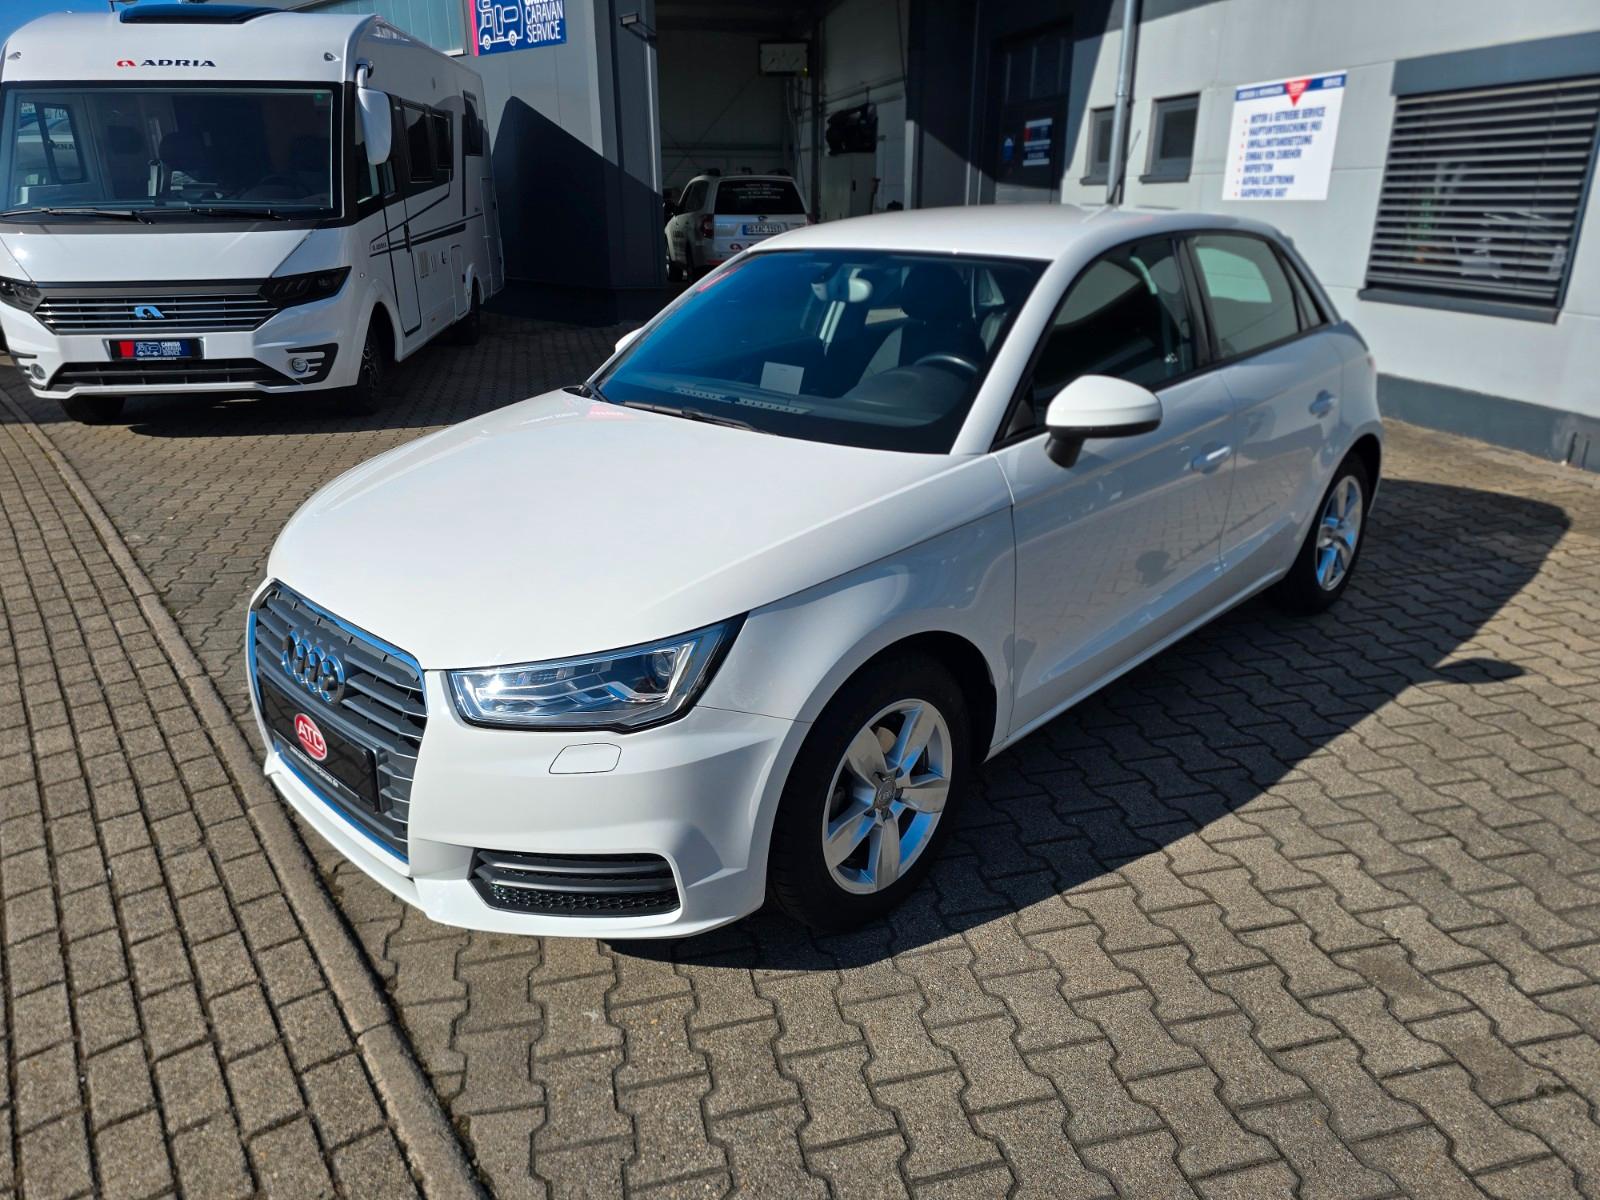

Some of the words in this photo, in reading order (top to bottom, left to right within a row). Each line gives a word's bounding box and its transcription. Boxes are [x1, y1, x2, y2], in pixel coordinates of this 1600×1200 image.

[525, 1, 563, 24] CARAVAN
[527, 20, 561, 43] SERVICE
[298, 720, 324, 751] ATC
